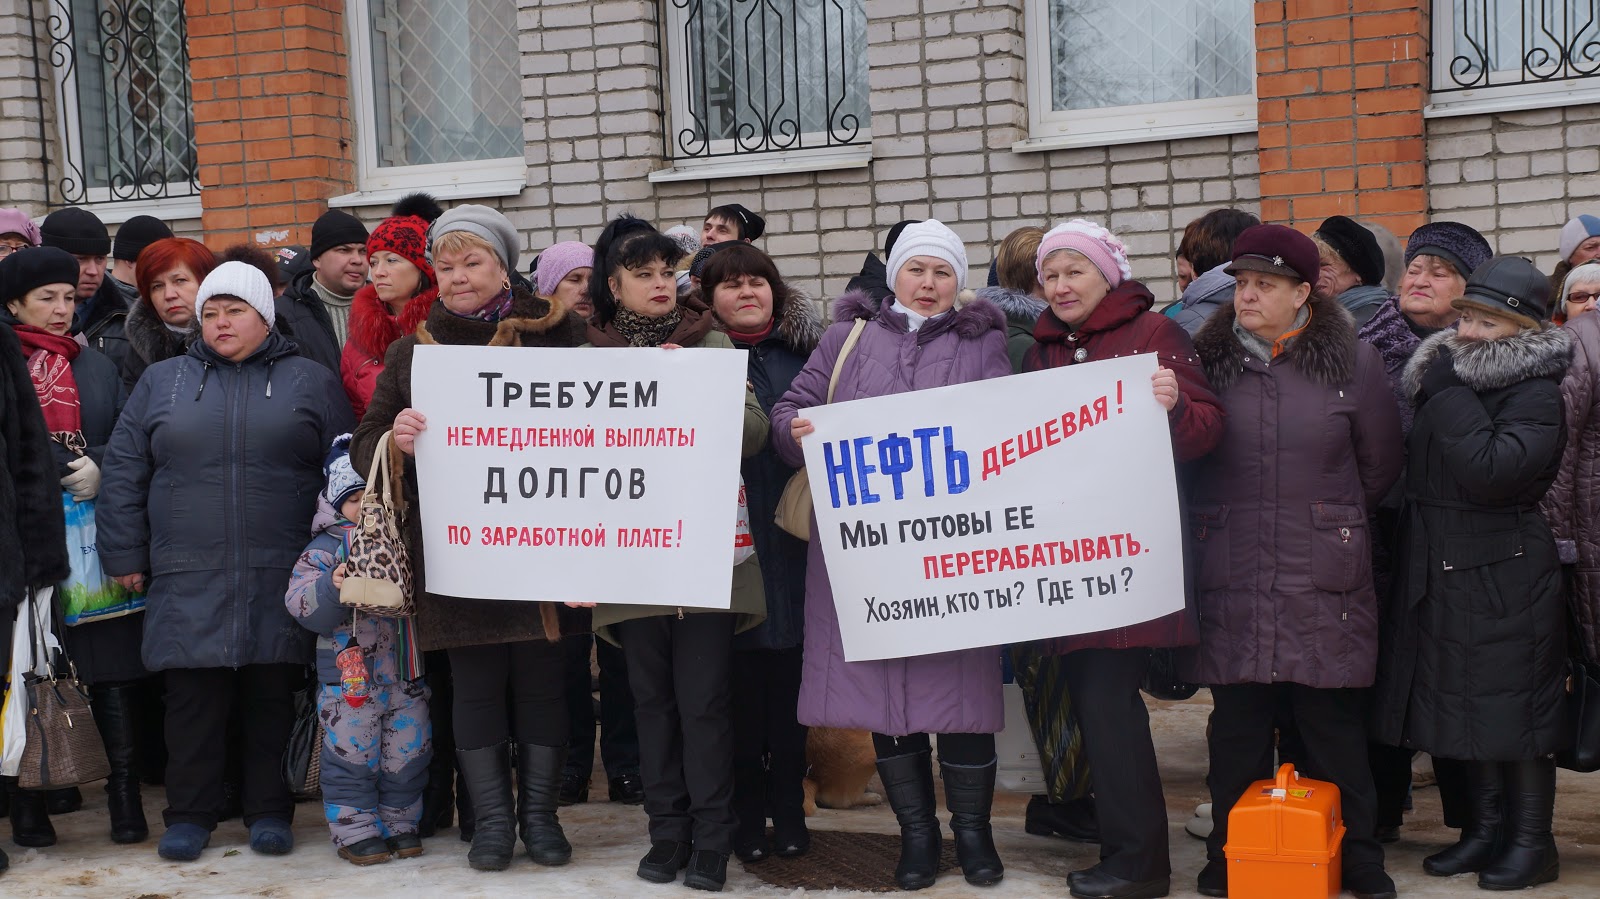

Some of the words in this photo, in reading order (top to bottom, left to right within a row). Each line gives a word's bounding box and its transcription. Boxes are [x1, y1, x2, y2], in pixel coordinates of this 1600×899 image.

[447, 424, 595, 452] НЕМЕДЛЕННОЙ
[605, 427, 696, 448] ВЫПЛАТЫ
[484, 466, 646, 504] ДОЛГОВ
[822, 425, 971, 509] НЕФТЬ
[447, 525, 472, 546] ПО
[481, 523, 606, 548] ЗАРАБОТНОЙ
[617, 519, 683, 548] ПЛАТЕ!
[923, 532, 1151, 580] ПЕРЕРАБАТЫВАТЬ.
